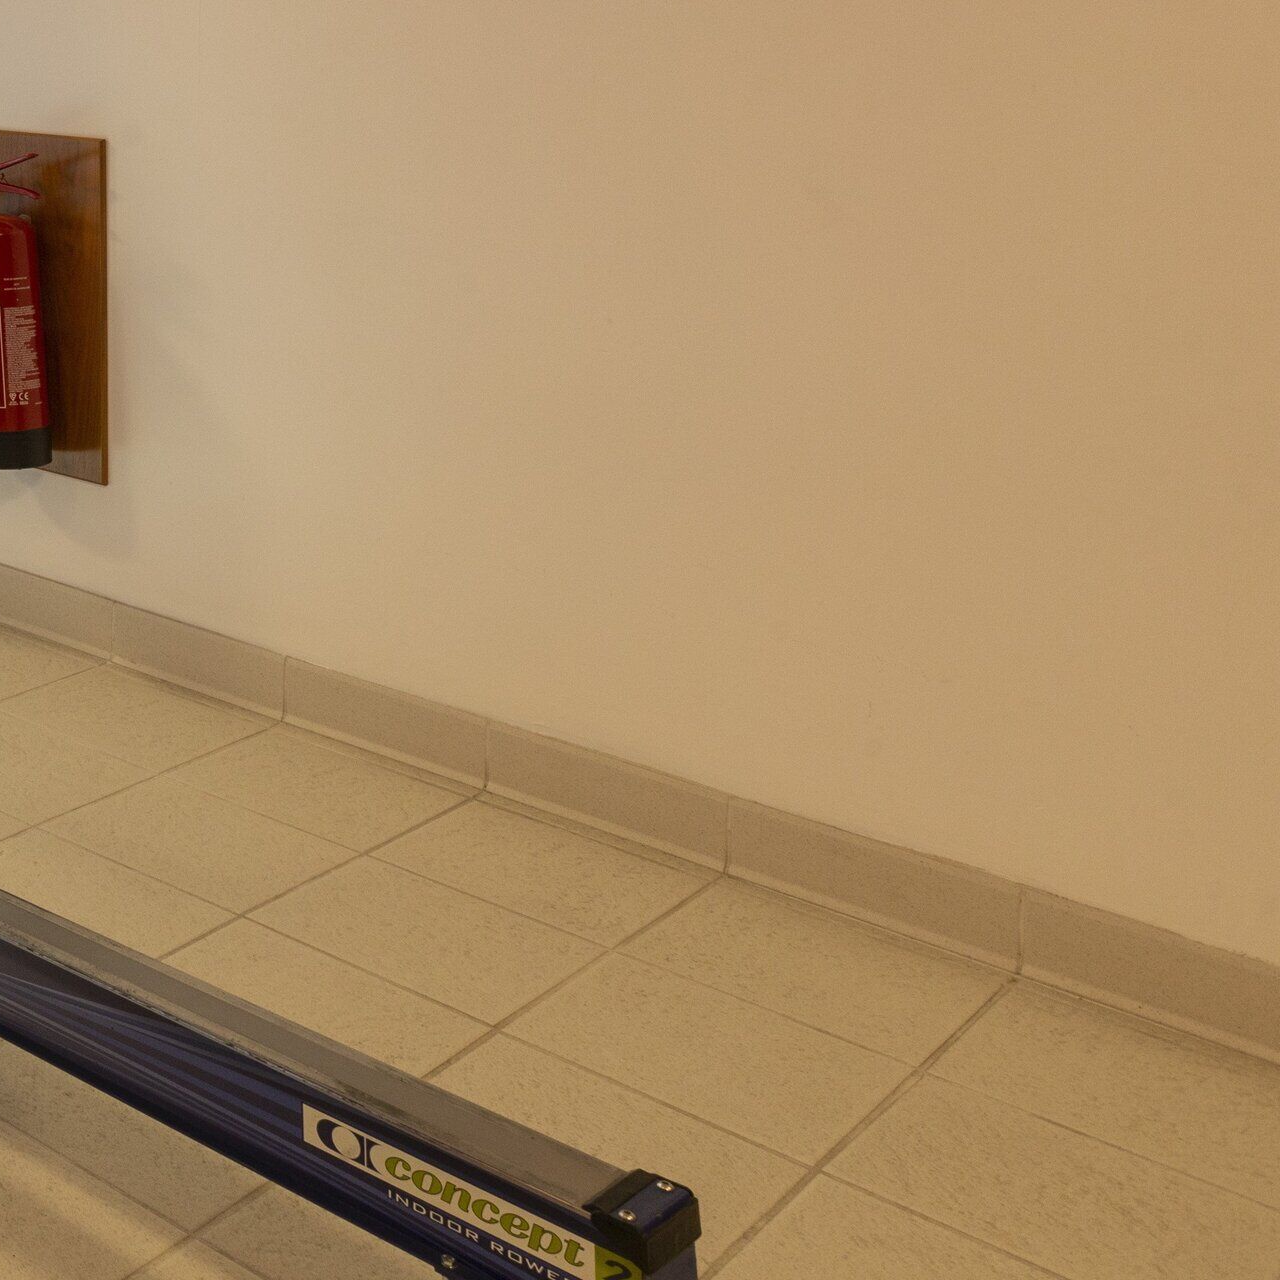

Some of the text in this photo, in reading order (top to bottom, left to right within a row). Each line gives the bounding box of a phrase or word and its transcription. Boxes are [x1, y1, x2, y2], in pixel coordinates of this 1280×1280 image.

[384, 1155, 586, 1268] concept
[388, 1189, 572, 1280] INDOOR ROWE
